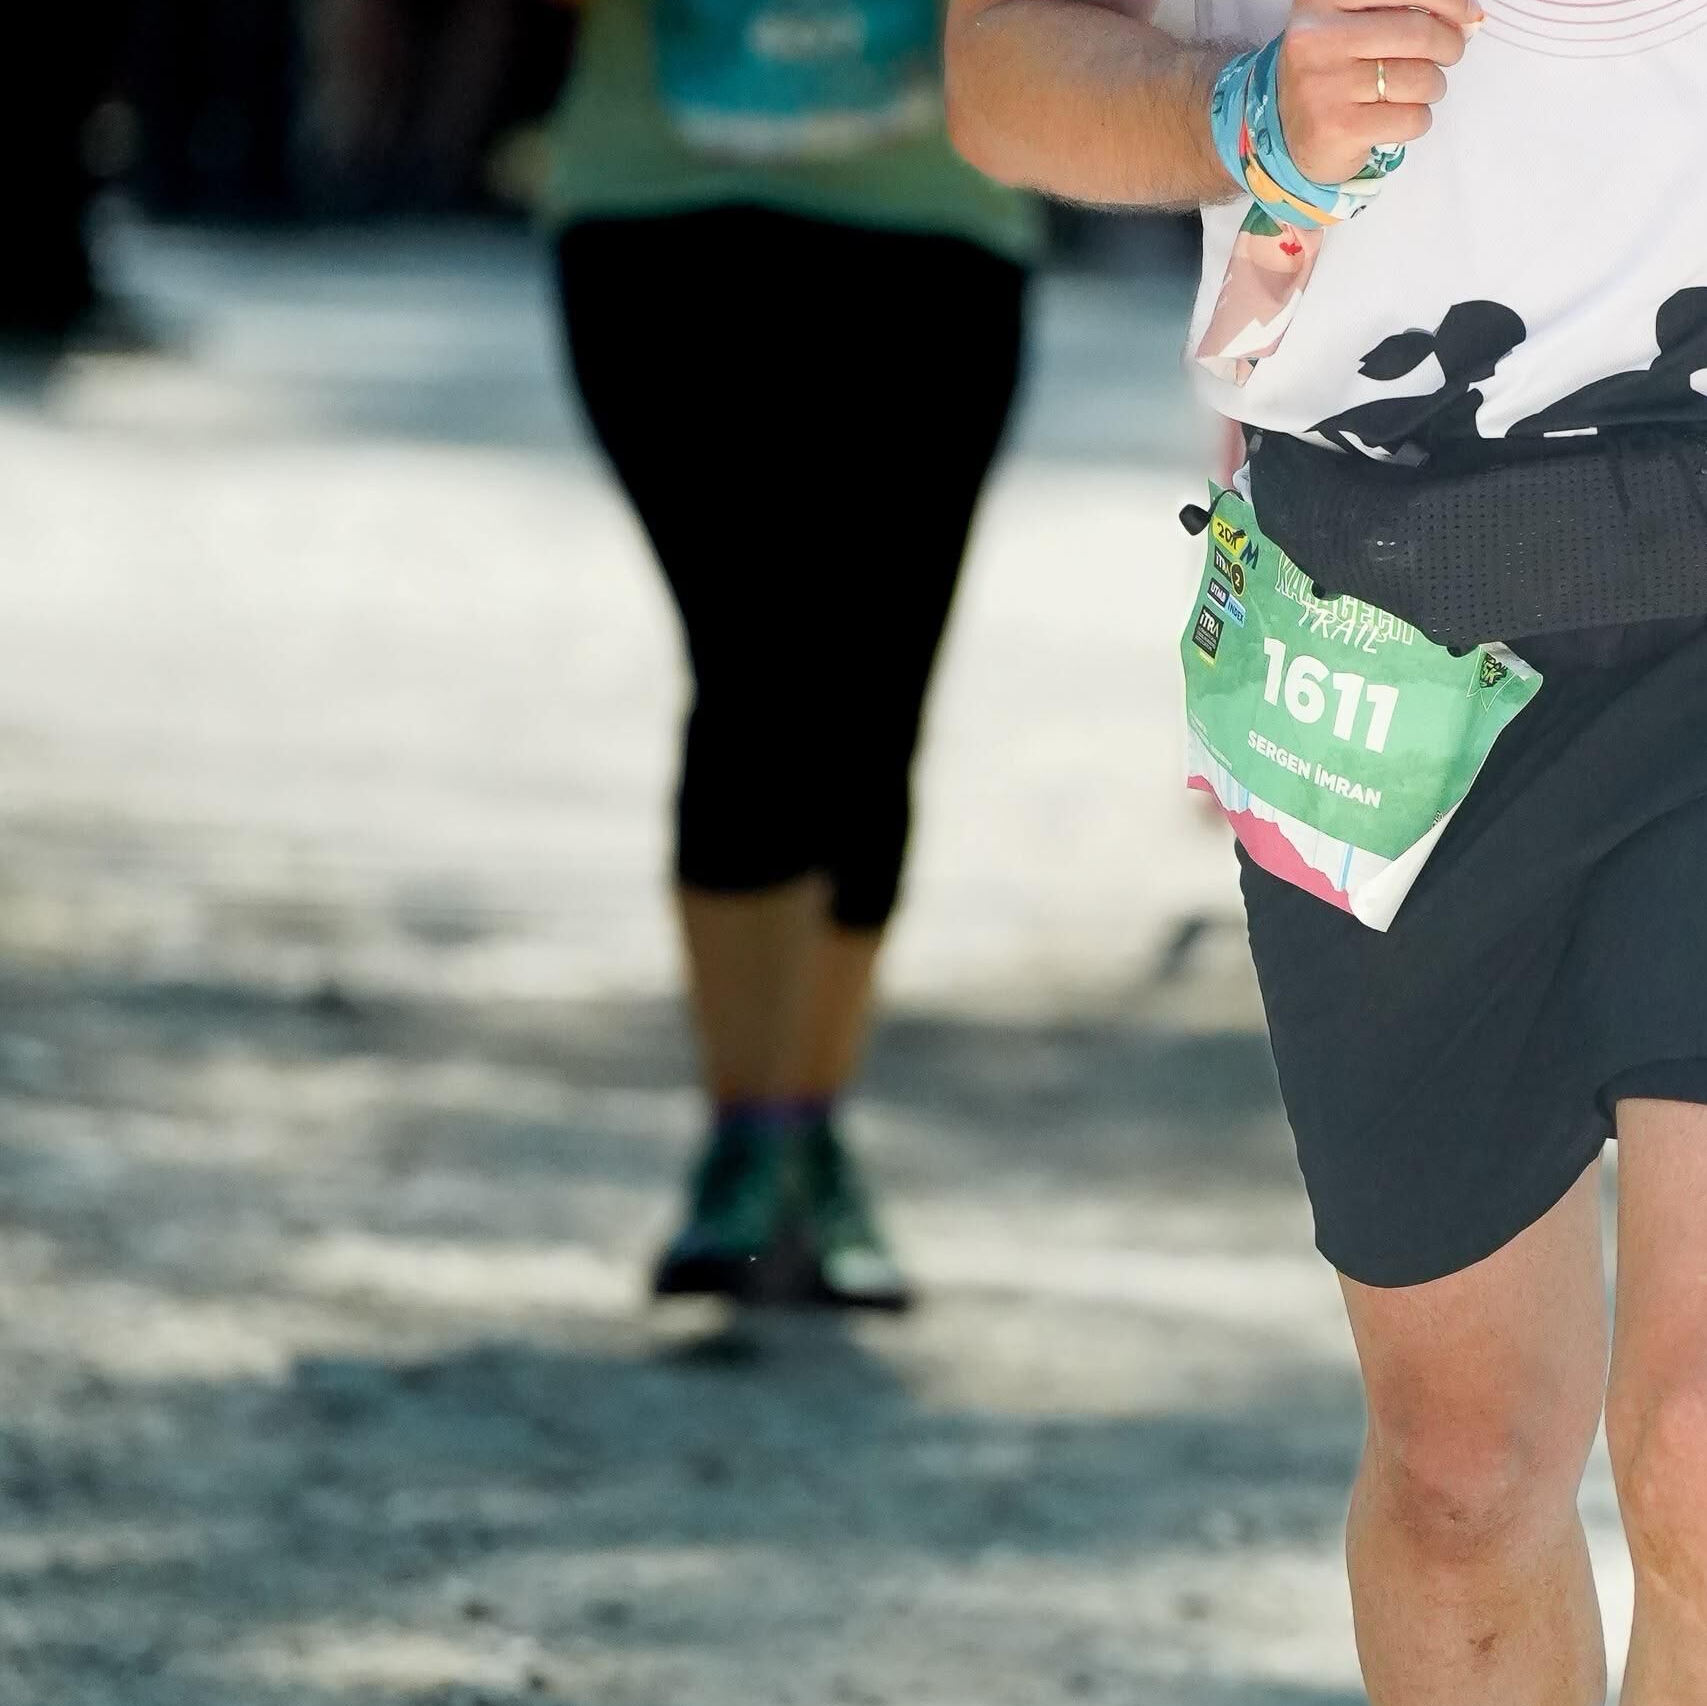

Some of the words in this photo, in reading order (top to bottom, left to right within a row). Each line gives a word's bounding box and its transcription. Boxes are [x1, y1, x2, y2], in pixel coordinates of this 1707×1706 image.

[1234, 572, 1241, 587] 2
[1227, 601, 1244, 624] INDEX
[1298, 601, 1377, 654] TRAIL
[1263, 636, 1399, 754] 1611
[1247, 729, 1311, 780] SERGEN
[1314, 763, 1382, 809] İMRAN
